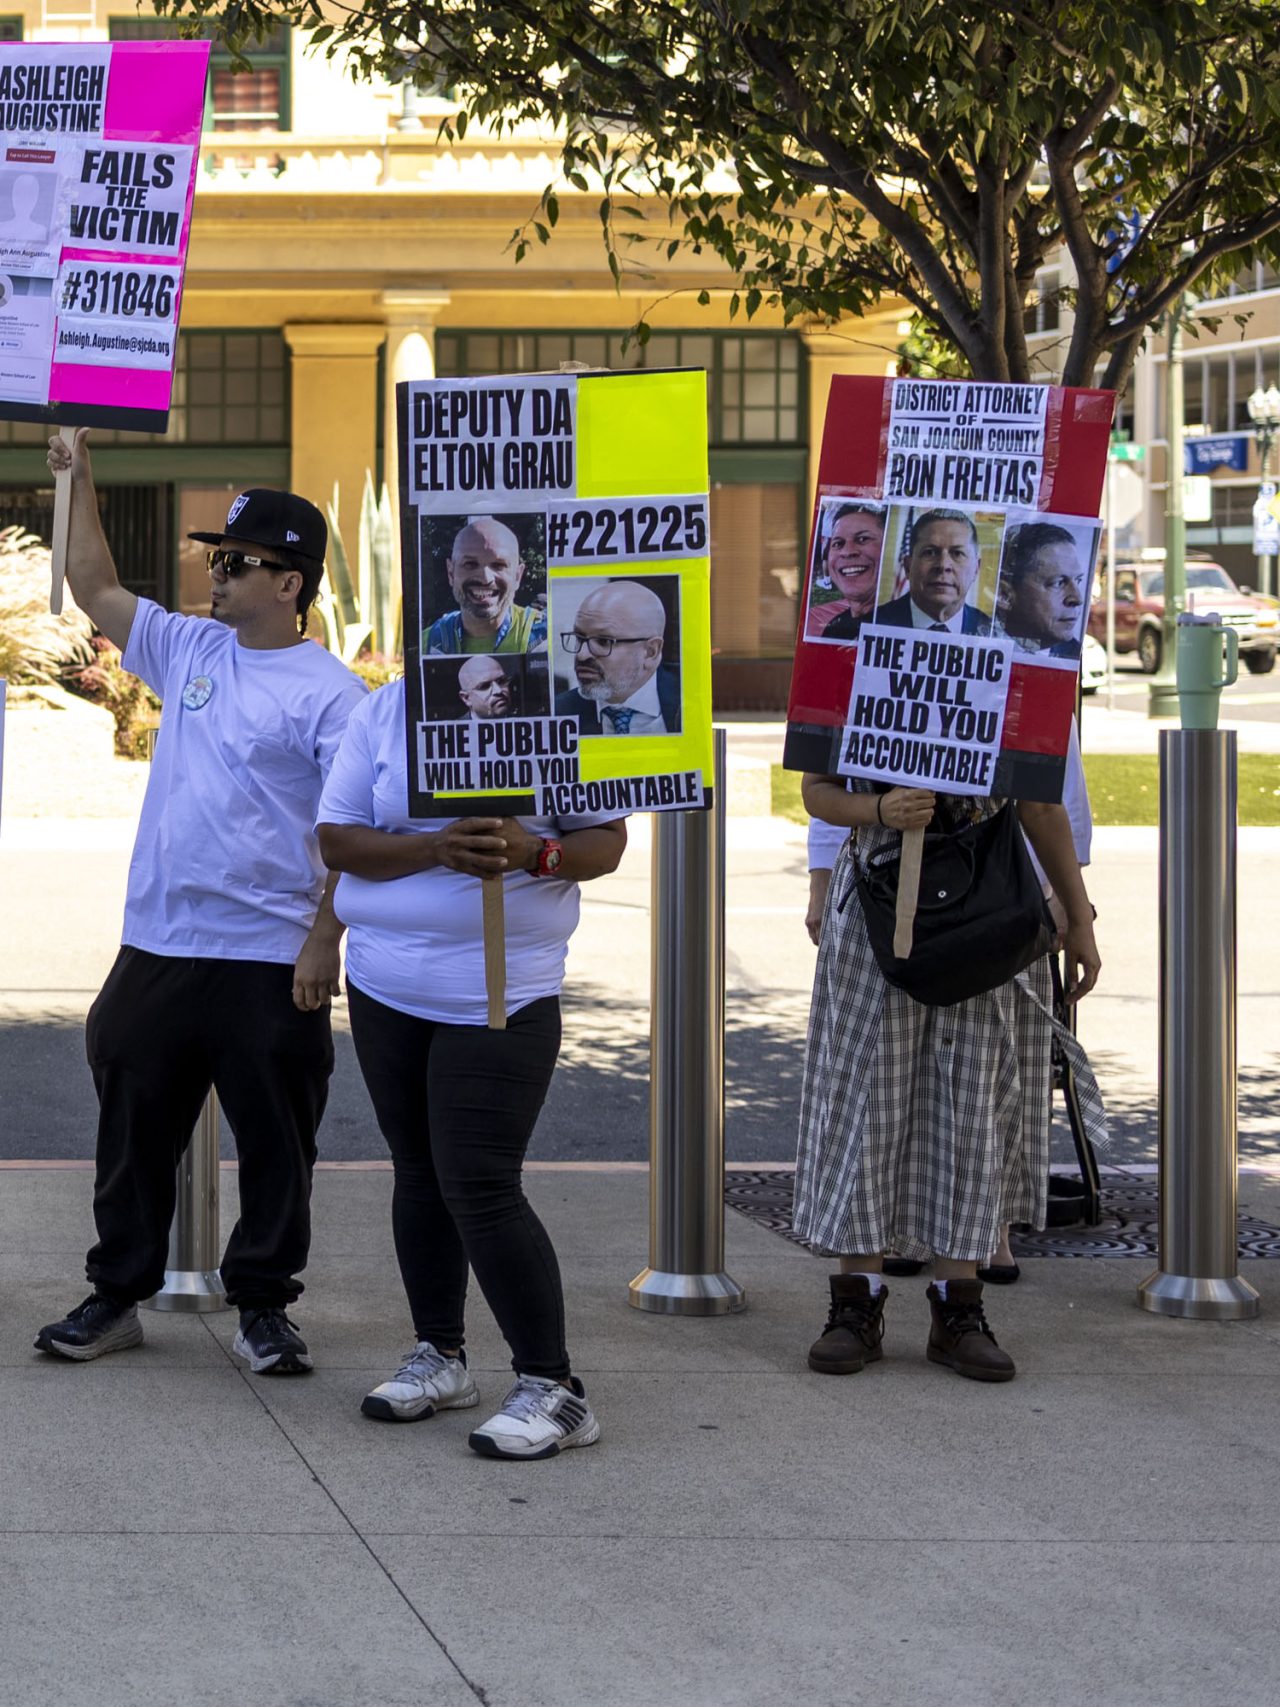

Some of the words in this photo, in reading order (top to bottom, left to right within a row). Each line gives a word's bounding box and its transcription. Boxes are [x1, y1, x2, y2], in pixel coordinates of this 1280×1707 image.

[80, 149, 176, 189] FAILS
[105, 185, 148, 209] THE
[69, 204, 180, 246] VICTIM
[21, 249, 51, 258] Augustine
[61, 268, 175, 318] #311846
[58, 331, 171, 357] Ashleigh.Augustine@sjcda.org
[413, 389, 524, 438] DEPUTY
[532, 388, 573, 436] DA
[895, 385, 960, 413] DISTRICT
[964, 387, 1045, 415] ATTORNEY
[955, 414, 979, 426] OF
[891, 427, 920, 449] SAN
[922, 427, 984, 452] JOAQUIN
[987, 428, 1041, 454] COUNTY
[414, 442, 495, 492] ELTON
[503, 440, 573, 490] GRAU
[889, 454, 937, 500] RON
[941, 456, 1038, 506] FREITAS
[548, 504, 707, 558] #221225
[862, 635, 904, 671] THE
[913, 640, 1004, 683] PUBLIC
[889, 672, 973, 707] WILL
[421, 724, 473, 760] THE
[478, 719, 578, 757] PUBLIC
[853, 696, 929, 734] HOLD
[939, 705, 998, 744] YOU
[424, 763, 474, 790] WILL
[479, 760, 533, 789] HOLD
[537, 757, 579, 784] YOU
[844, 732, 993, 787] ACCOUNTABLE
[541, 771, 698, 816] ACCOUNTABLE
